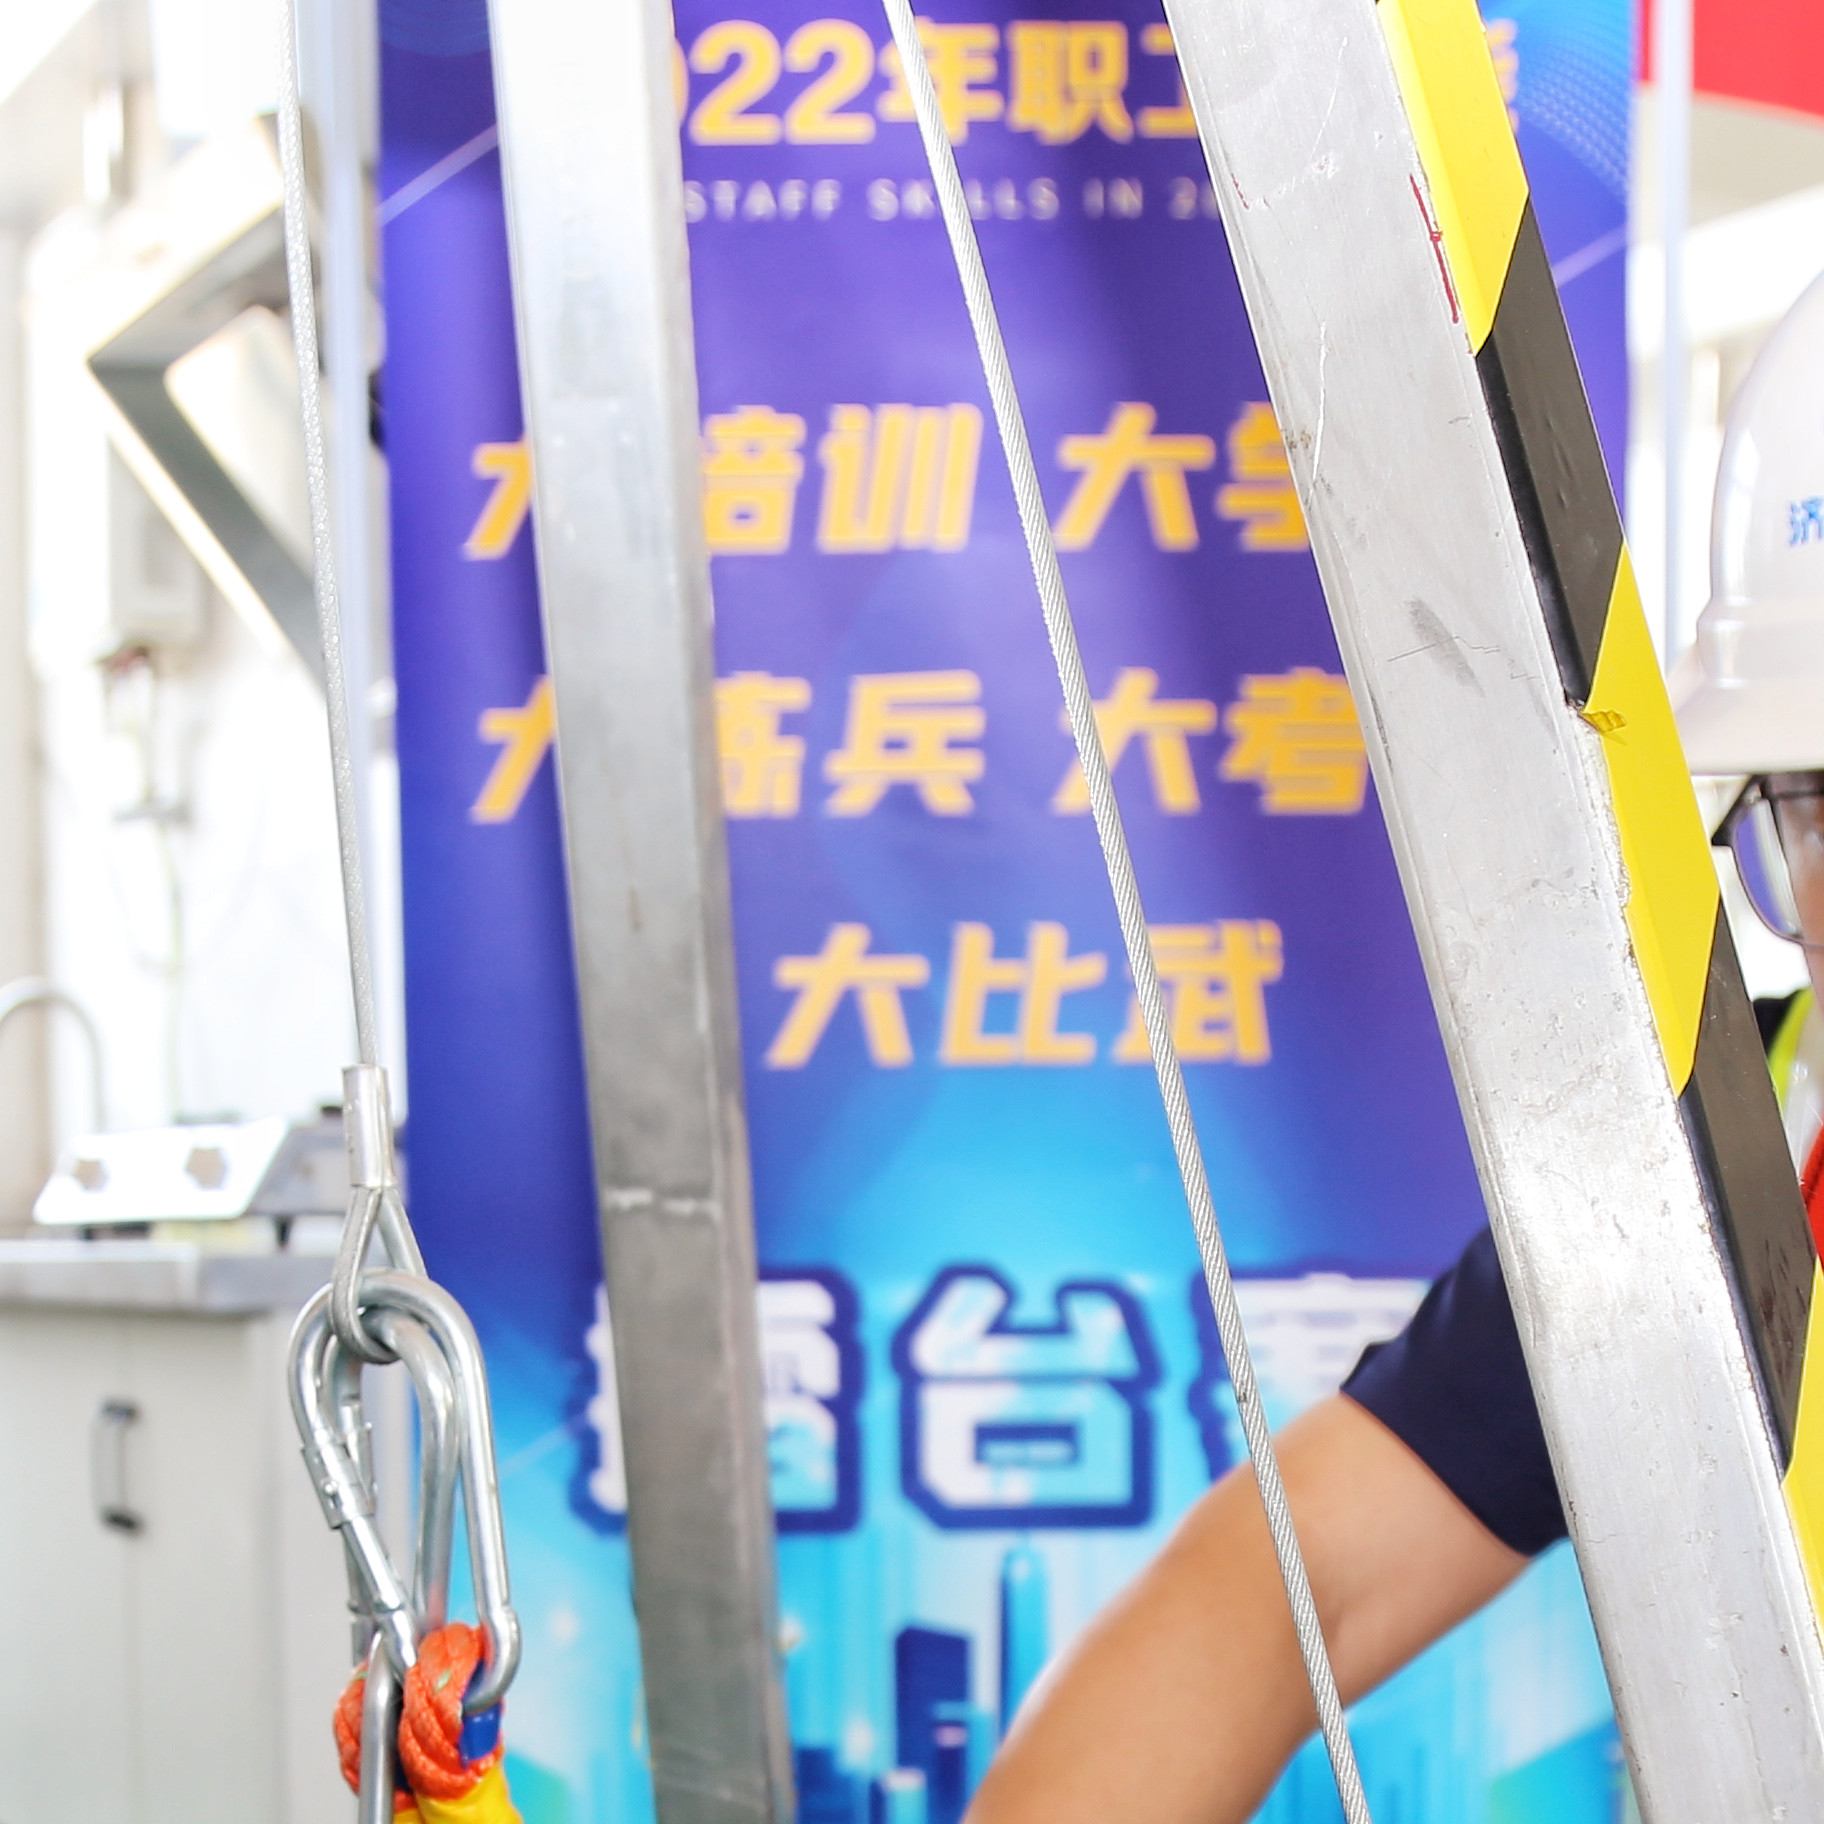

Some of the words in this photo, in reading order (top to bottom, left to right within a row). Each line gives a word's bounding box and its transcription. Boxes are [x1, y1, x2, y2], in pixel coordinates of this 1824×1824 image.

[866, 177, 1061, 222] SKLLS
[766, 918, 1284, 1070] 大比武
